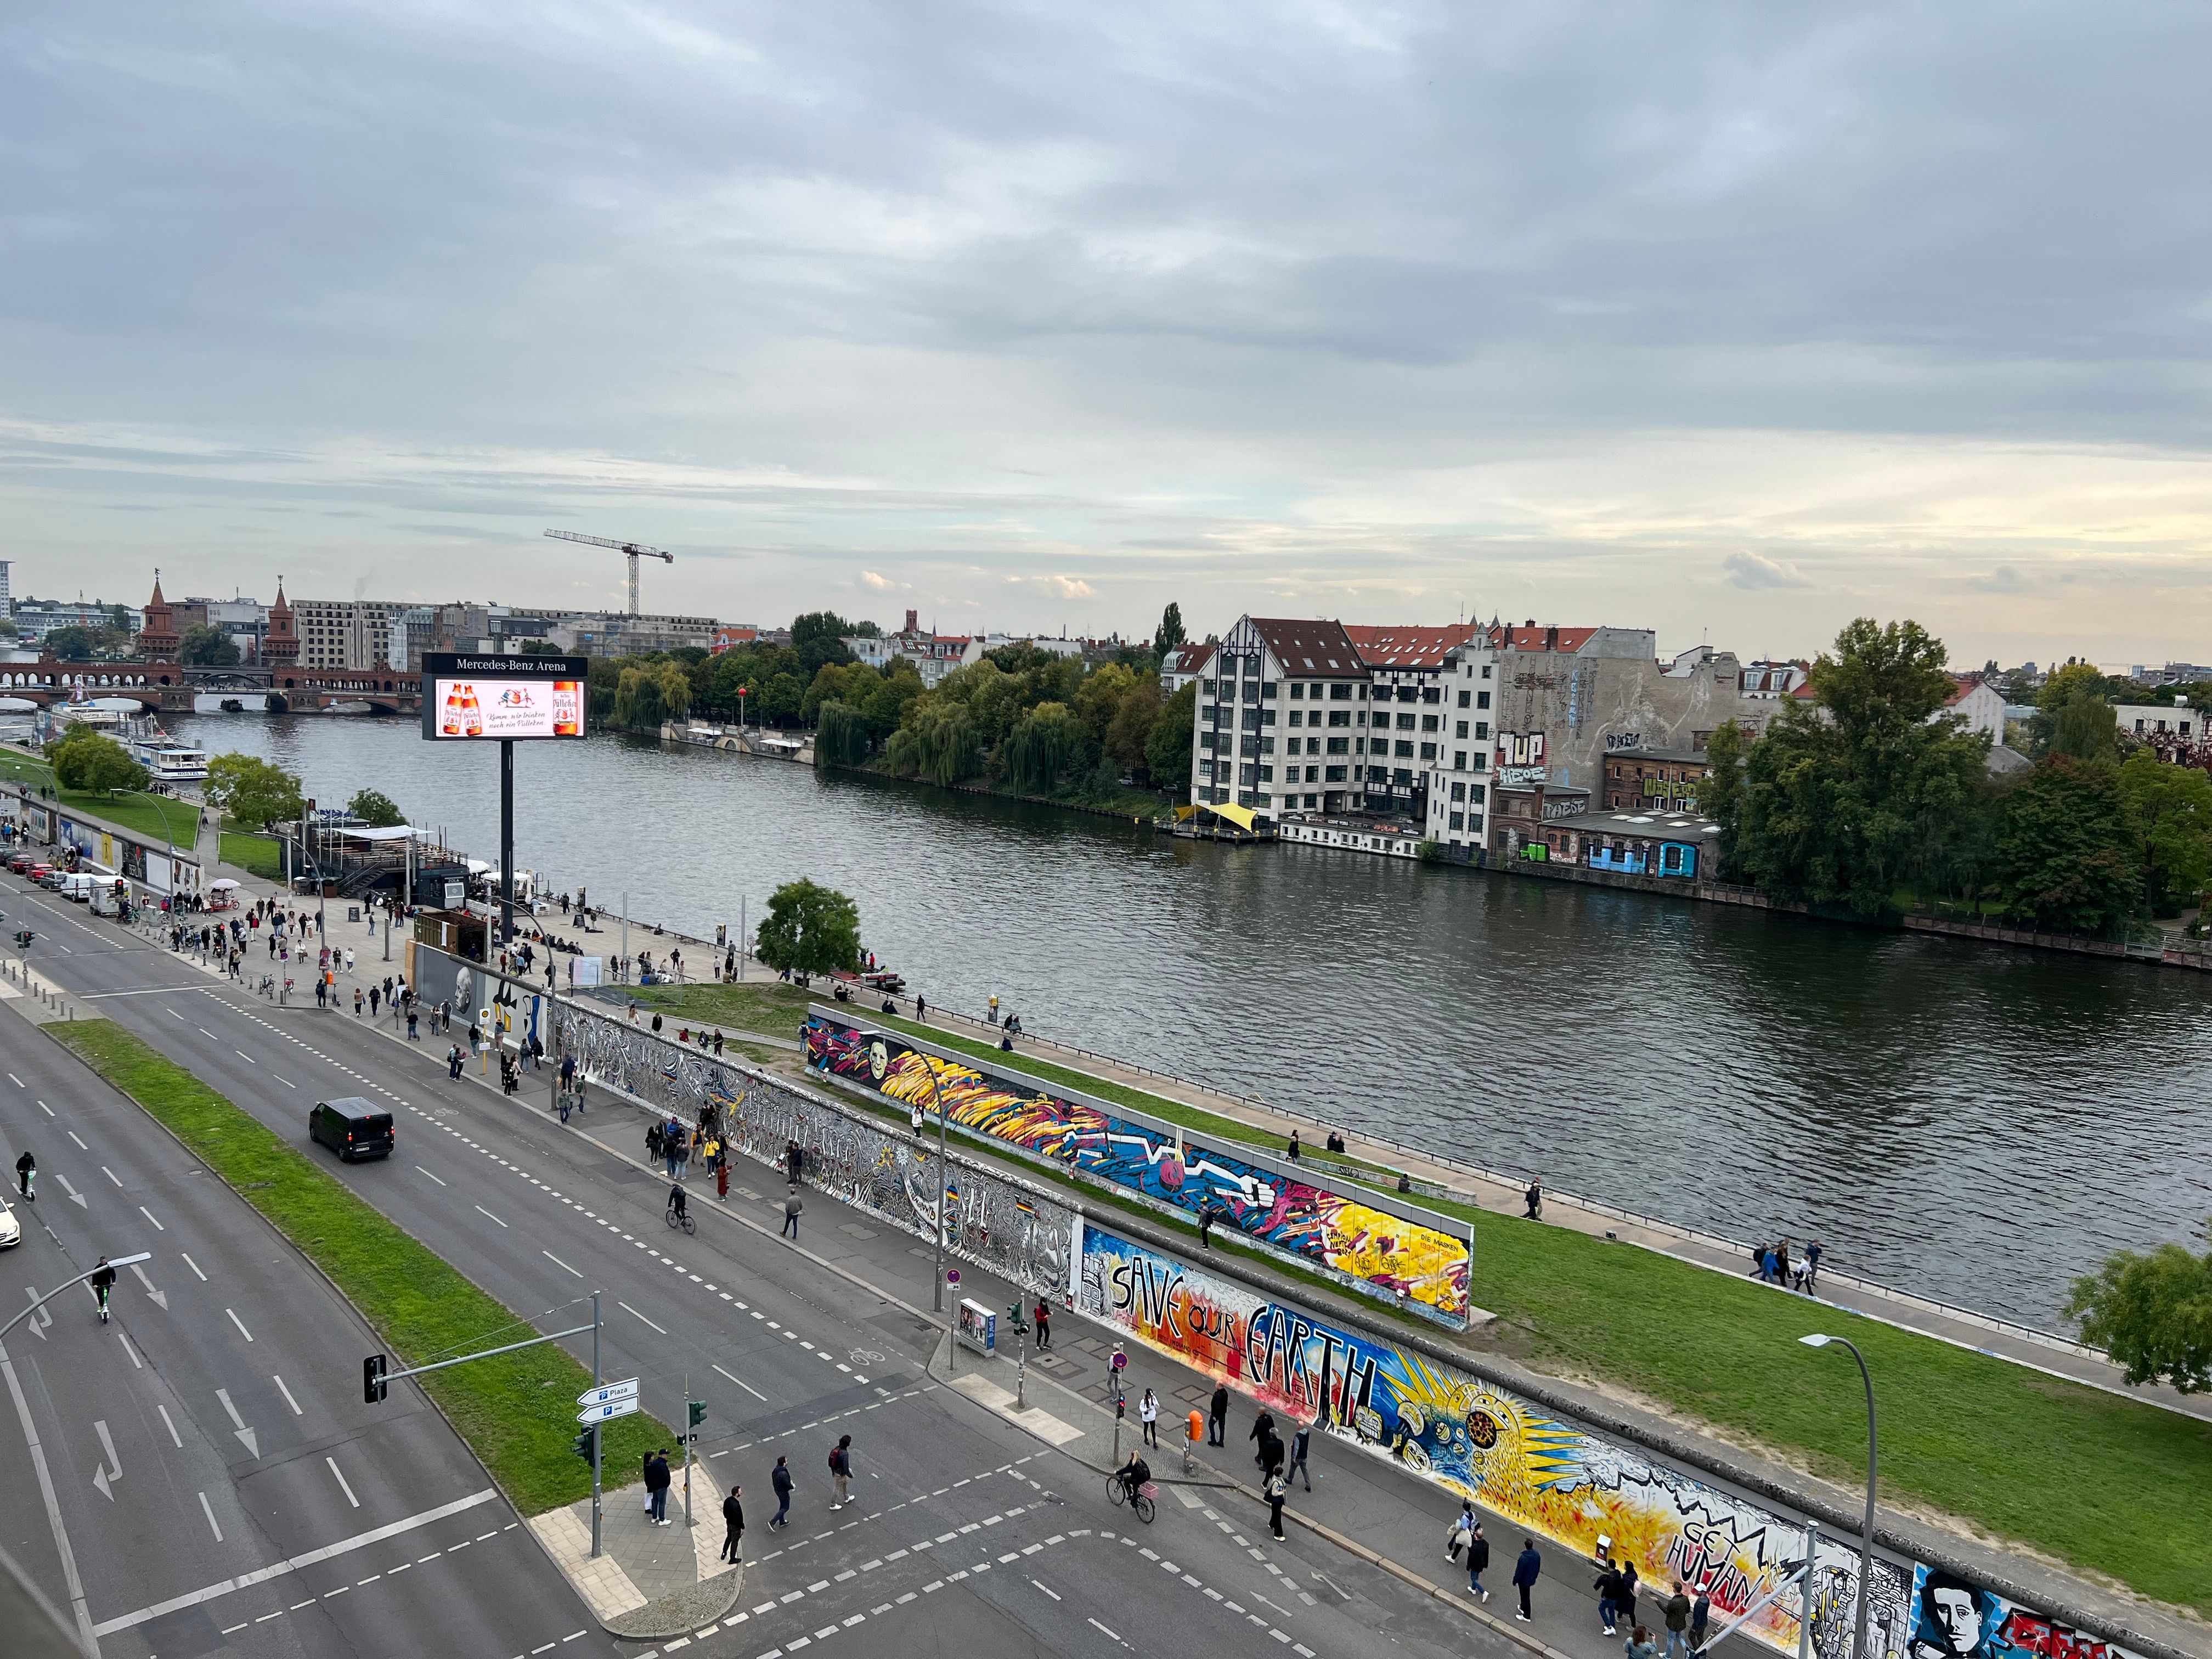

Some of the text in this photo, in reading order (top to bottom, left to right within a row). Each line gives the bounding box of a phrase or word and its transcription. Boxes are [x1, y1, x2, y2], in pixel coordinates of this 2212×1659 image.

[457, 658, 566, 672] Mercedes-Benz Arena
[1421, 1234, 1458, 1252] DIE MASKEN
[1111, 1256, 1184, 1339] SAVE
[1188, 1304, 1242, 1351] OUR
[1246, 1305, 1377, 1426] EARTH
[611, 1387, 628, 1396] Plaza
[1683, 1522, 1741, 1562] GET
[1666, 1534, 1766, 1607] HUMAN
